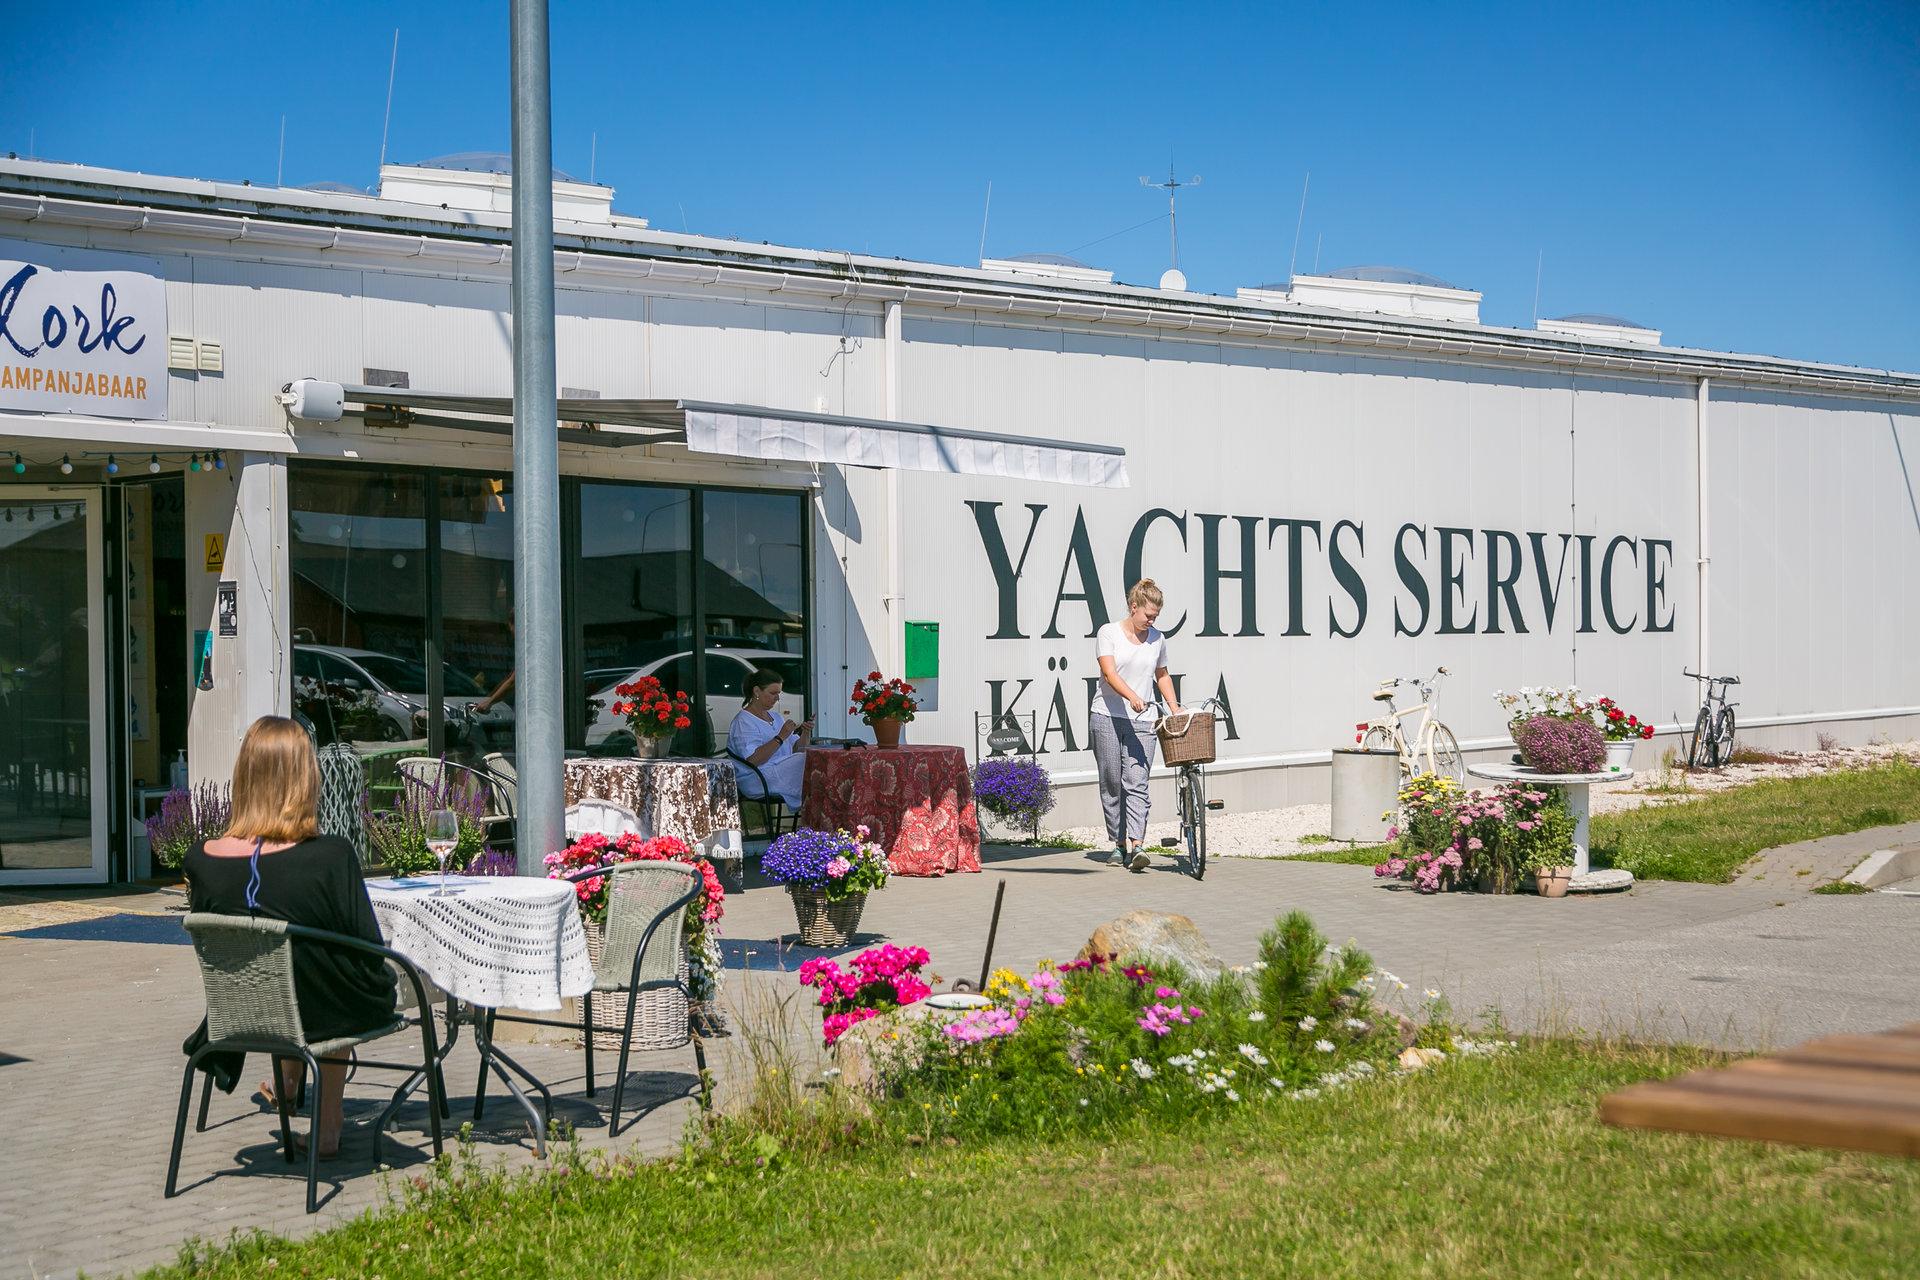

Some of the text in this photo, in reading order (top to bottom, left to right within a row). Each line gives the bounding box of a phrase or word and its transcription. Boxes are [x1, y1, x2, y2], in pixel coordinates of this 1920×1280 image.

[1, 365, 146, 399] AMPANJABAAR
[964, 500, 1675, 639] YACHTS SERVICE
